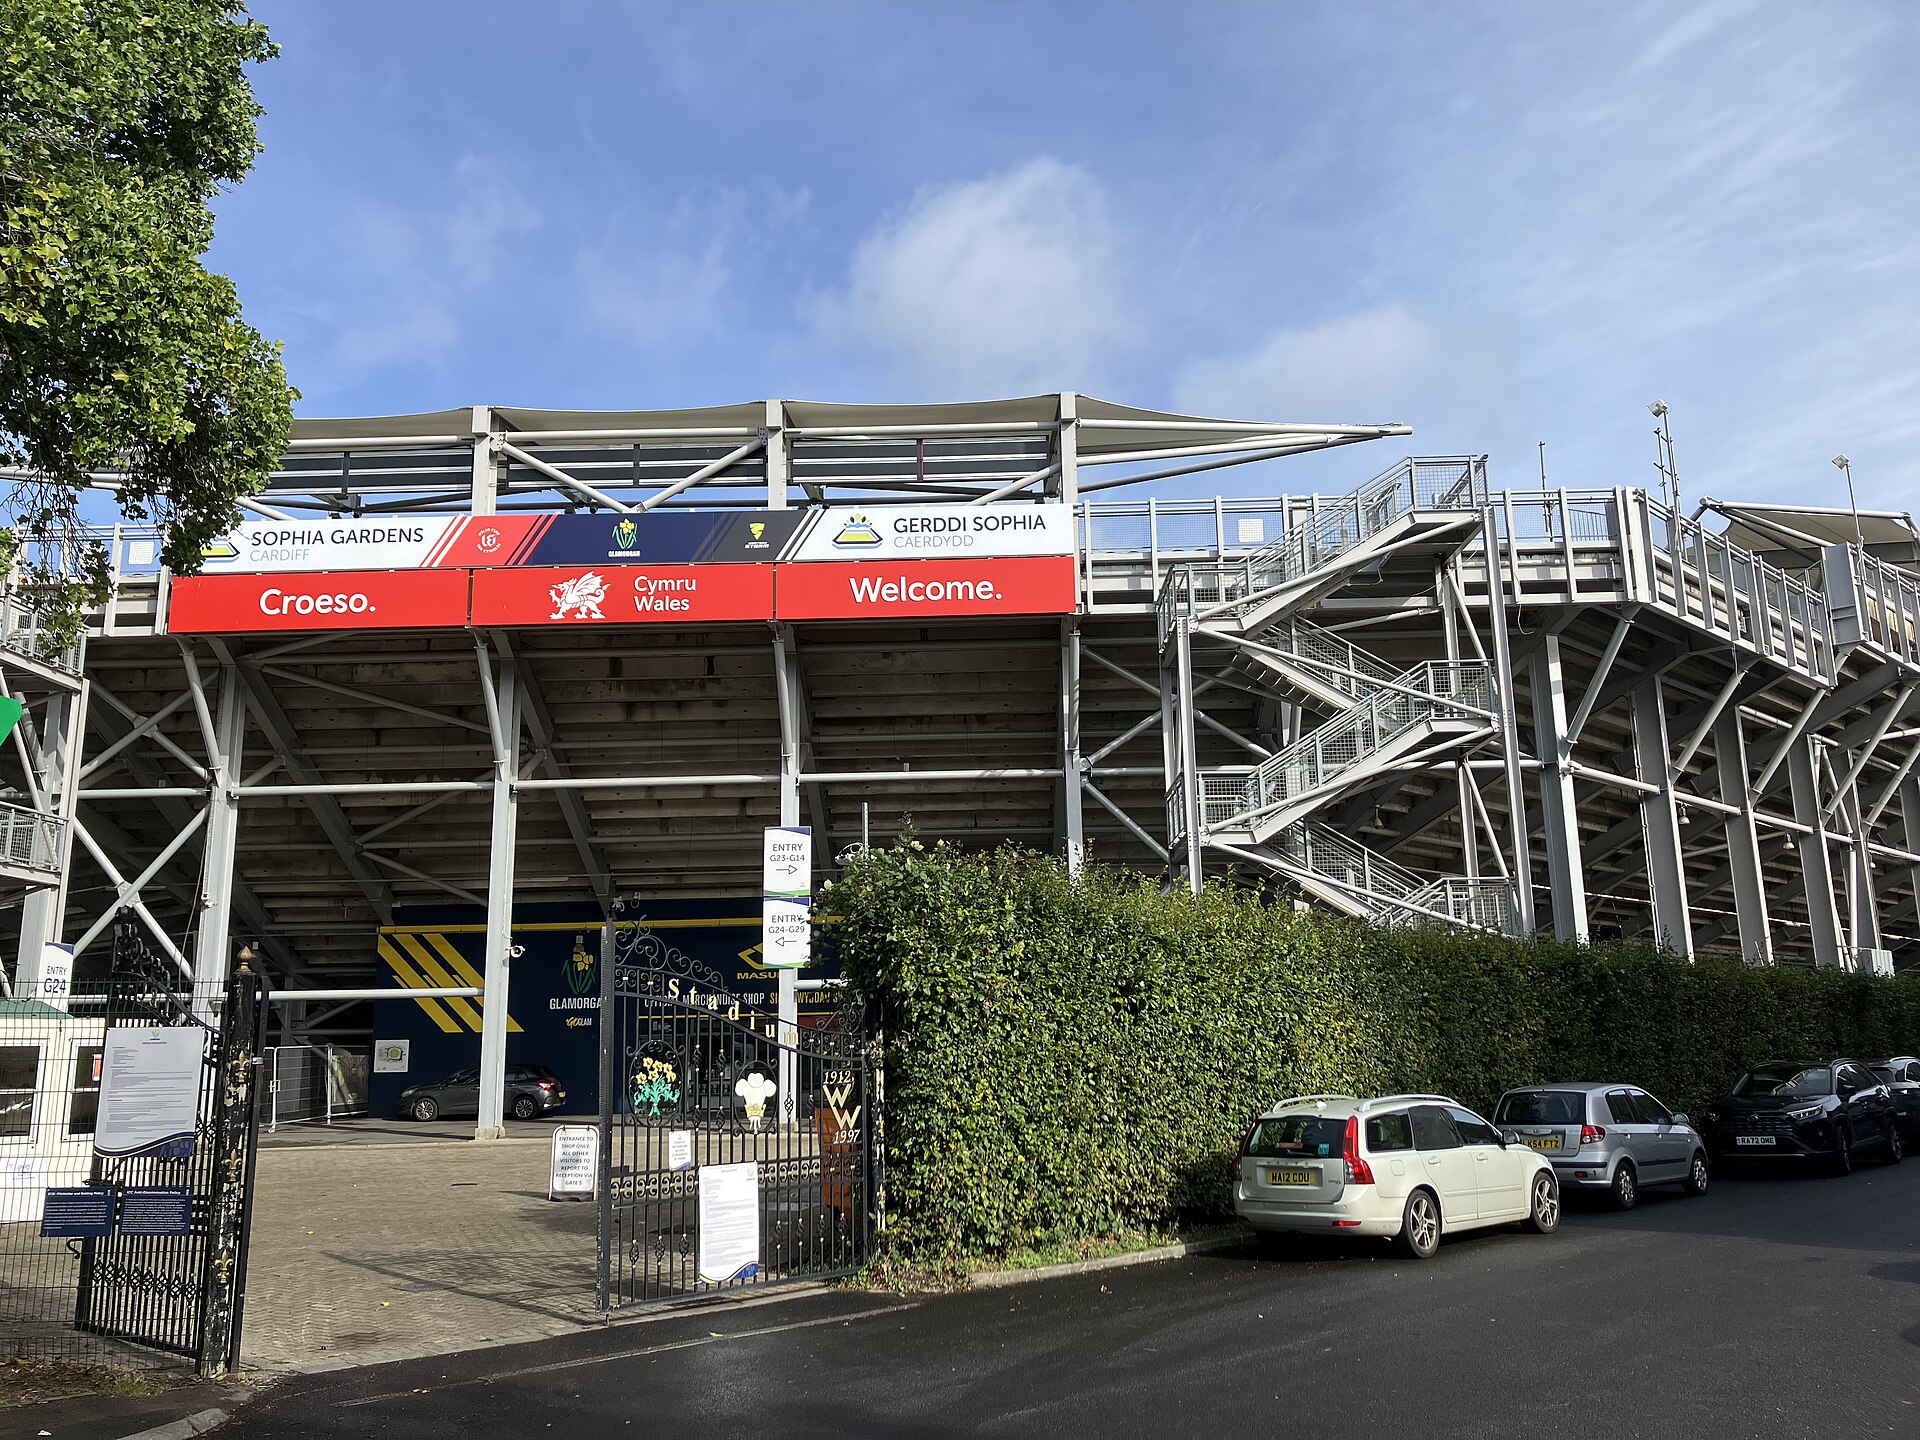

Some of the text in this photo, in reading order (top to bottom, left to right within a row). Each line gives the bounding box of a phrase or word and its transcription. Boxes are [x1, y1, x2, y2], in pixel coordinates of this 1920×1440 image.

[893, 514, 1046, 533] GERDDI SOPHIA
[251, 527, 424, 546] SOPHIA GARDENS
[893, 534, 974, 548] CAERDYDD
[250, 548, 310, 562] CARDIFF
[634, 575, 697, 596] Cymru
[849, 576, 1003, 603] Welcome.
[259, 588, 376, 615] Croeso.
[633, 595, 690, 612] Wales
[772, 843, 804, 852] ENTRY
[769, 854, 806, 862] G23-G14
[771, 914, 804, 923] ENTRY
[768, 925, 806, 933] G24-G29
[46, 965, 68, 975] ENTRY
[736, 971, 779, 980] MASU
[43, 977, 67, 993] G24
[549, 997, 602, 1009] GLAMORGA
[743, 992, 765, 1005] SHOP
[823, 1070, 851, 1084] 1912
[833, 1129, 860, 1145] 1997
[1543, 1140, 1559, 1148] FTZ
[1271, 1172, 1310, 1183] MA12 CDU
